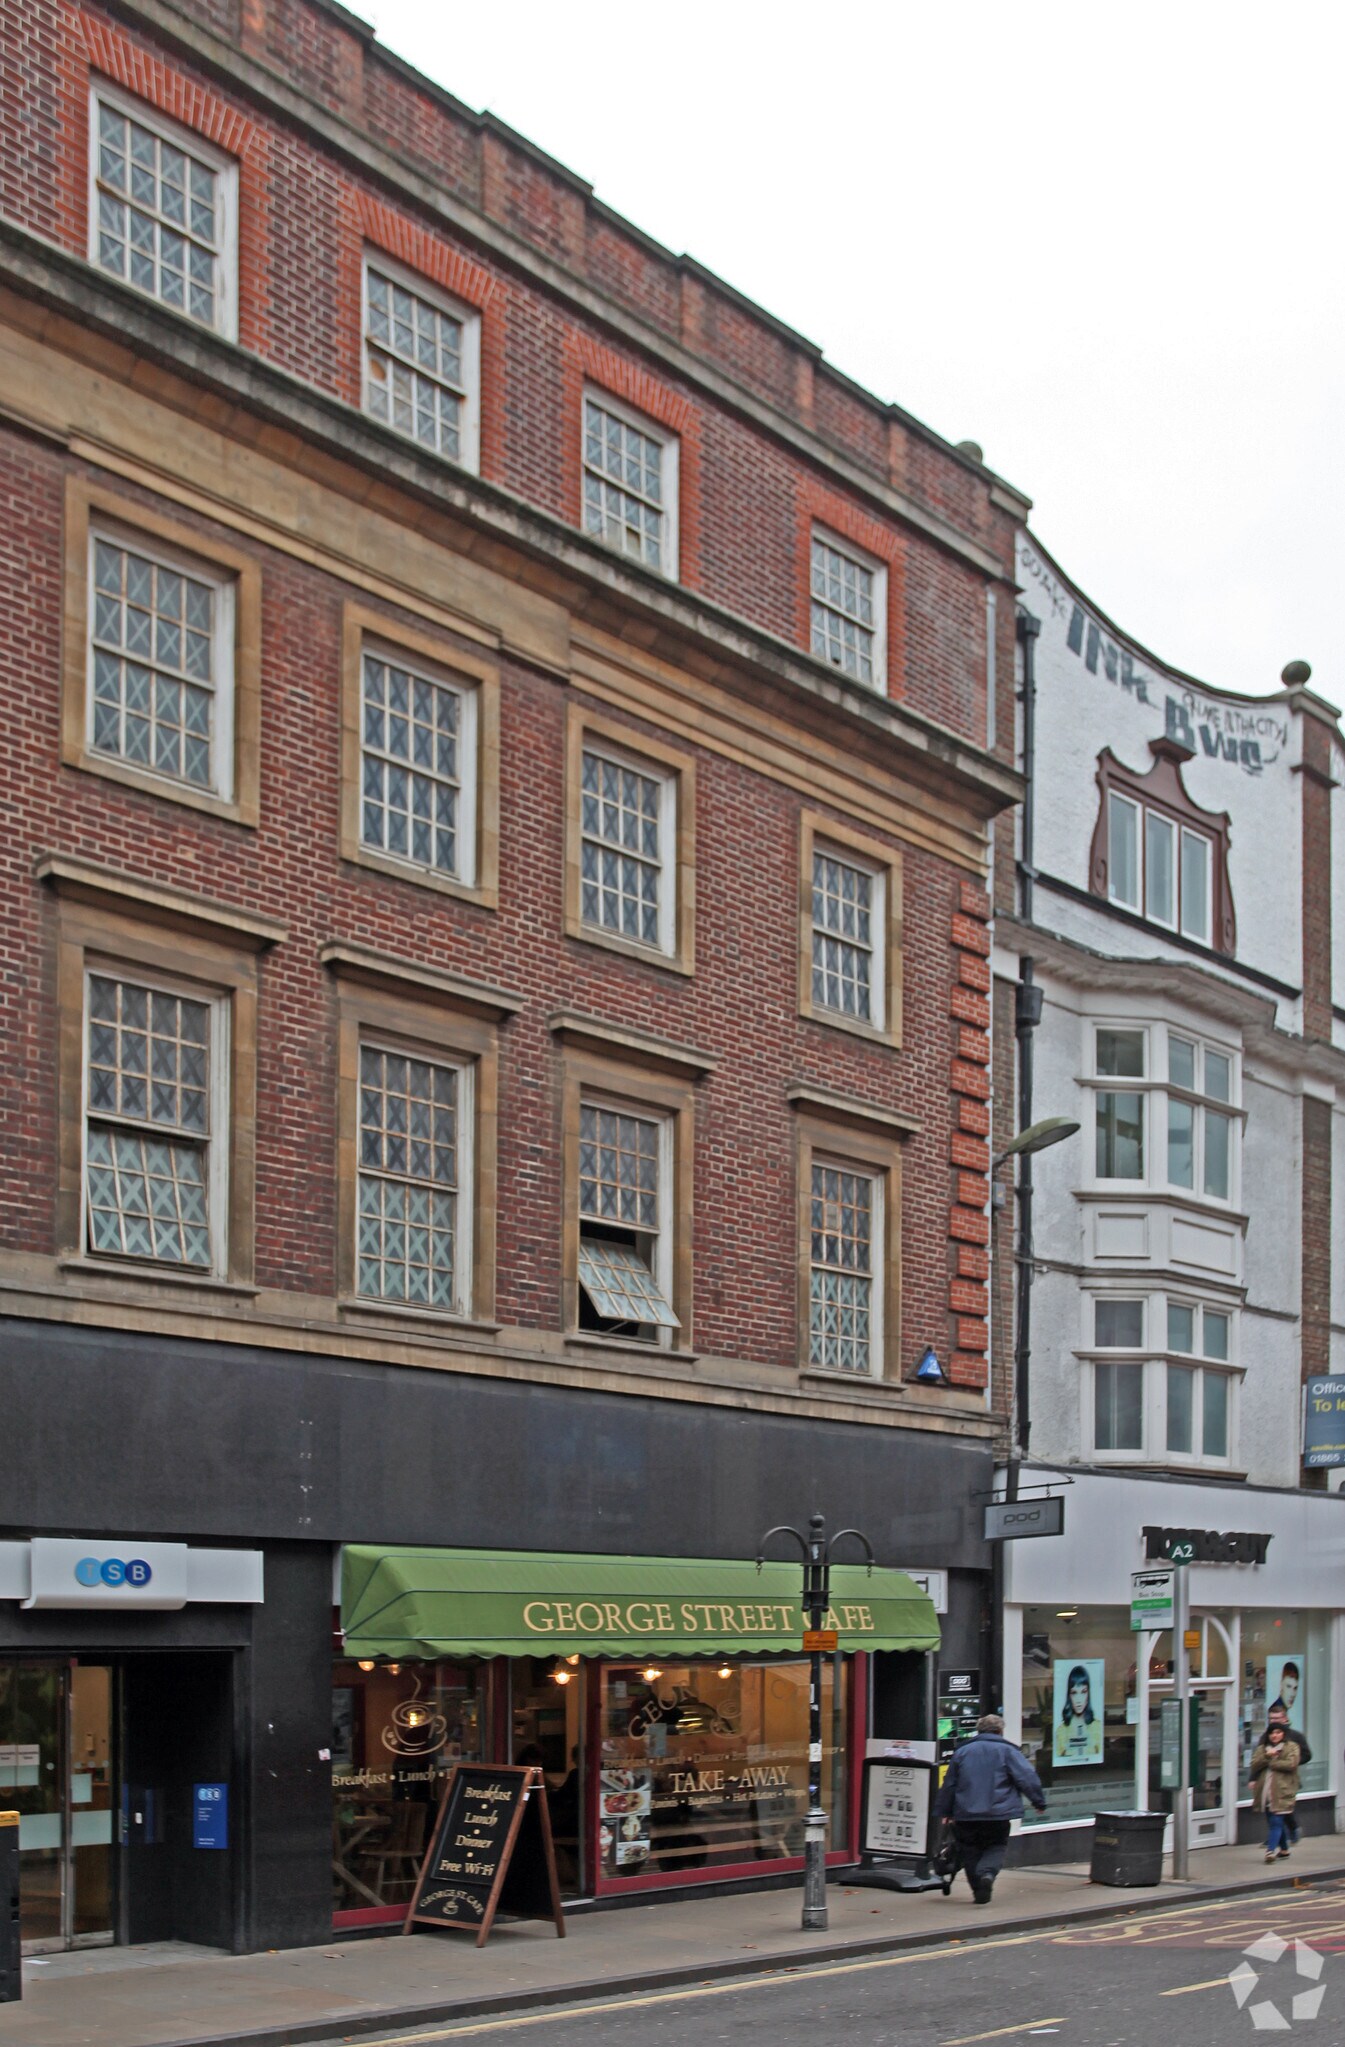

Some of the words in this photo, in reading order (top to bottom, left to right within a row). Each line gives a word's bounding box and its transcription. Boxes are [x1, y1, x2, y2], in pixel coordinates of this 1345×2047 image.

[1313, 1399, 1332, 1412] To
[1003, 1509, 1041, 1525] pod
[1171, 1544, 1194, 1559] A2
[80, 1559, 149, 1584] TSB
[523, 1602, 675, 1633] GEORGE
[682, 1604, 794, 1633] STREET
[331, 1768, 387, 1788] Breakfast
[398, 1764, 435, 1782] Lunch
[464, 1784, 512, 1804] Breakfast
[464, 1810, 498, 1827] Lunch
[455, 1834, 493, 1848] Dinner
[439, 1859, 462, 1873] Free
